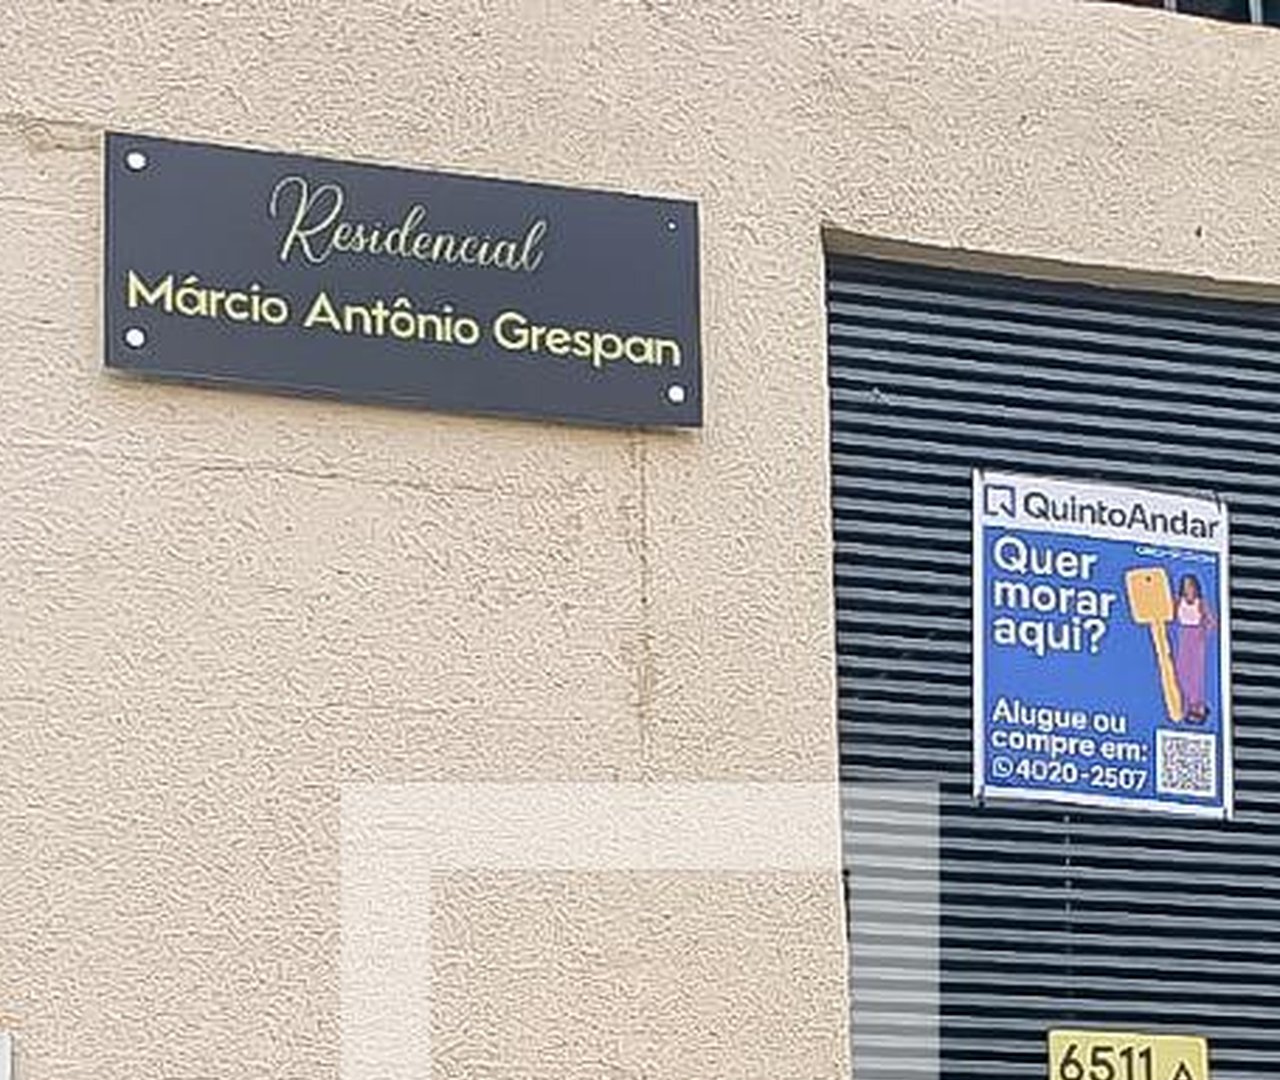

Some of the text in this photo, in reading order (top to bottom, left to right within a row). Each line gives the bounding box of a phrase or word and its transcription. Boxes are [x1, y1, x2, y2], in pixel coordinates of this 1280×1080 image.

[270, 176, 548, 272] Residencial
[126, 269, 681, 369] Márcio Antônio Grespan
[1023, 491, 1220, 539] QuintoAndar
[993, 536, 1098, 580] Quer
[993, 579, 1116, 618] morar
[993, 617, 1107, 657] aqui?
[991, 697, 1127, 733] Alugue ou
[991, 729, 1149, 762] compre em:
